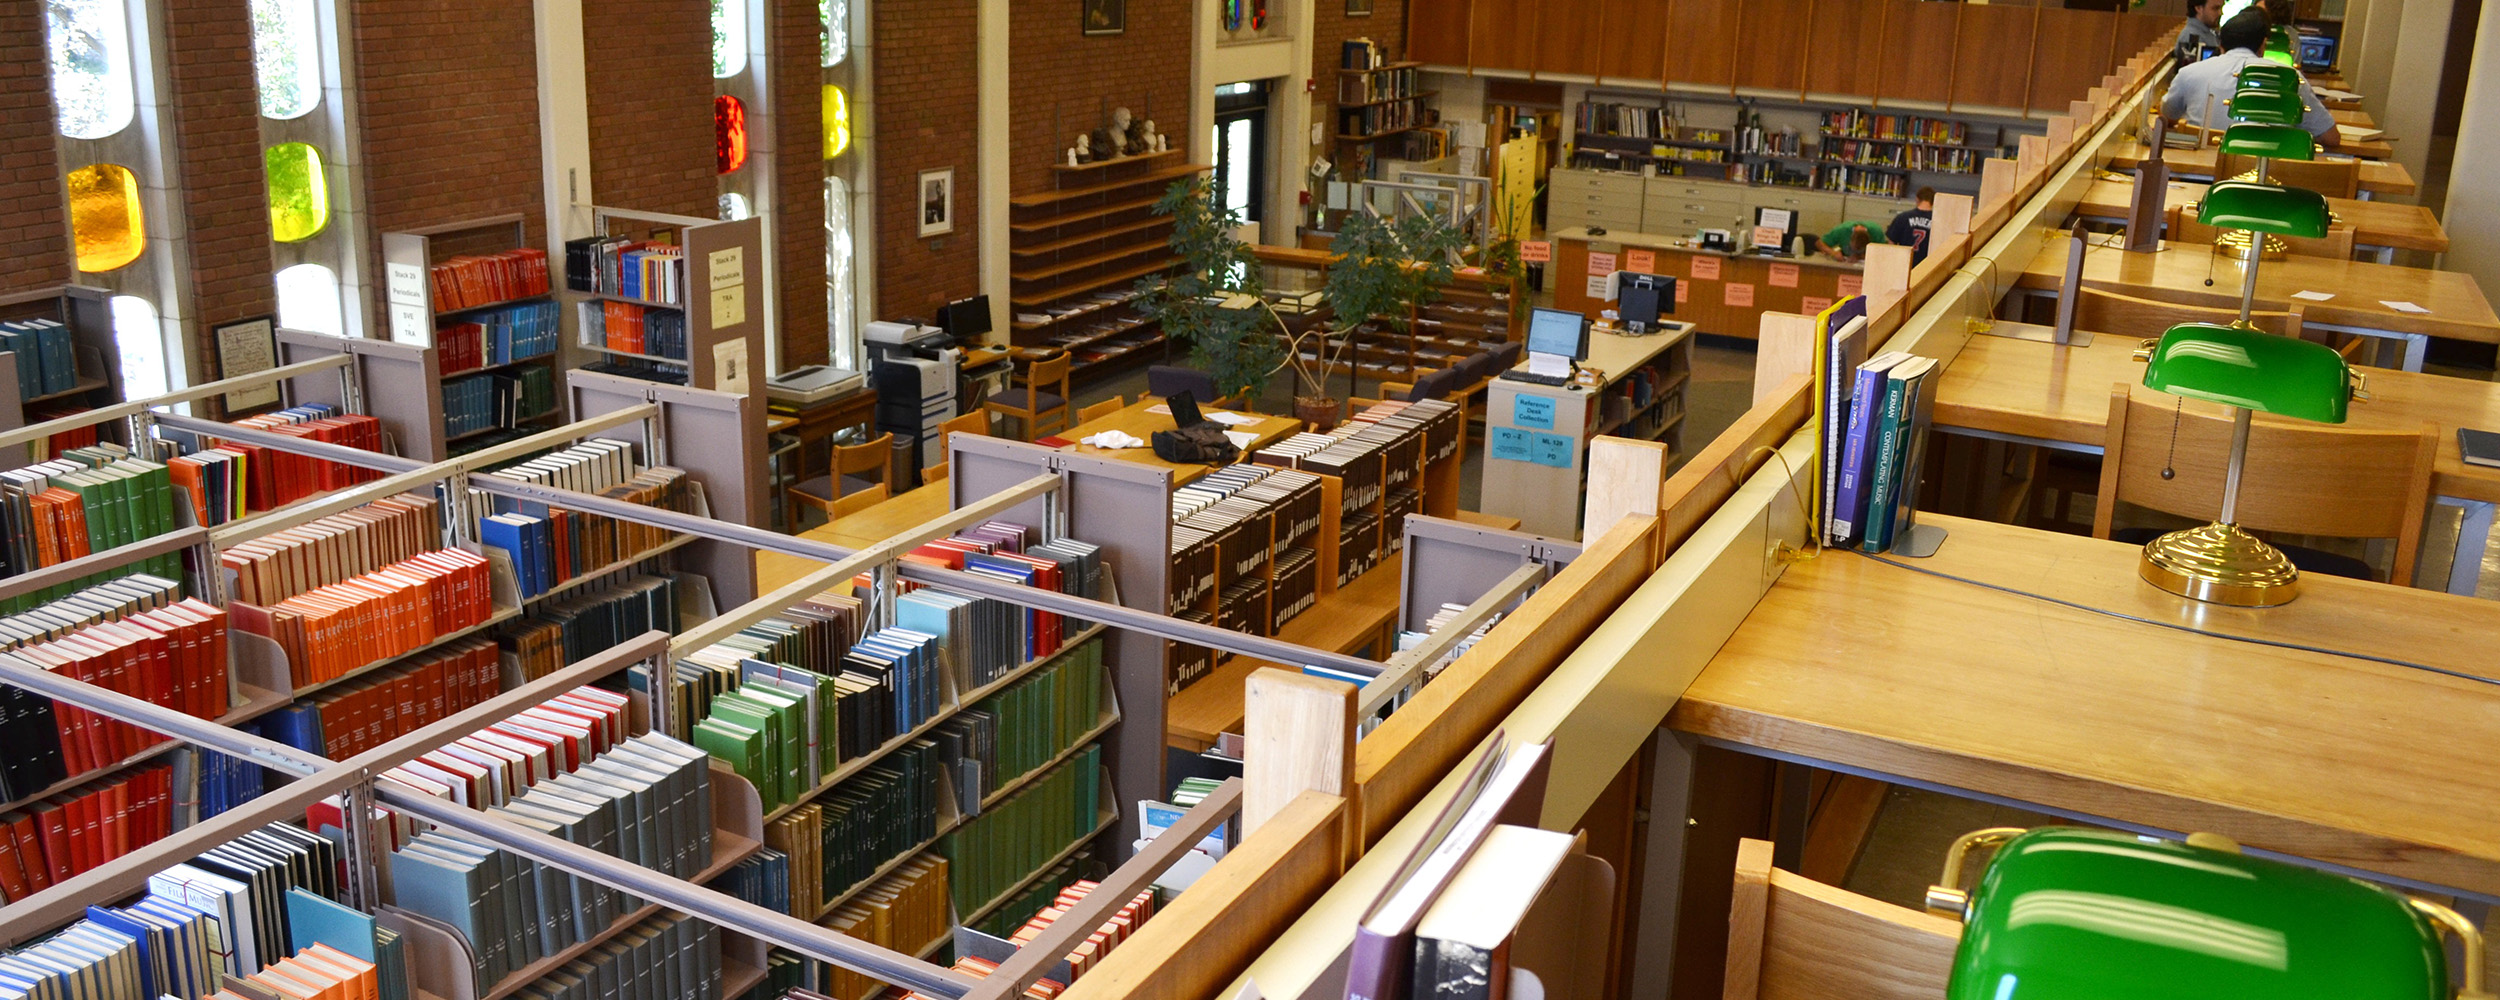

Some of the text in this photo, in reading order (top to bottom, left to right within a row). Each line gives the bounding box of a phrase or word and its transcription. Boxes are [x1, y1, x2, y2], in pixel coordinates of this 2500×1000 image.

[1912, 229, 1926, 251] 7
[395, 271, 416, 280] Stack 29
[714, 272, 740, 281] Periodicals
[393, 288, 420, 298] Periodicals
[722, 294, 733, 302] TRA
[403, 312, 414, 320] SVE
[1520, 399, 1551, 409] Reference
[1888, 390, 1898, 418] KERMAN
[1518, 413, 1549, 424] Collection
[1874, 431, 1892, 506] CONTEMPLATING MUSIC
